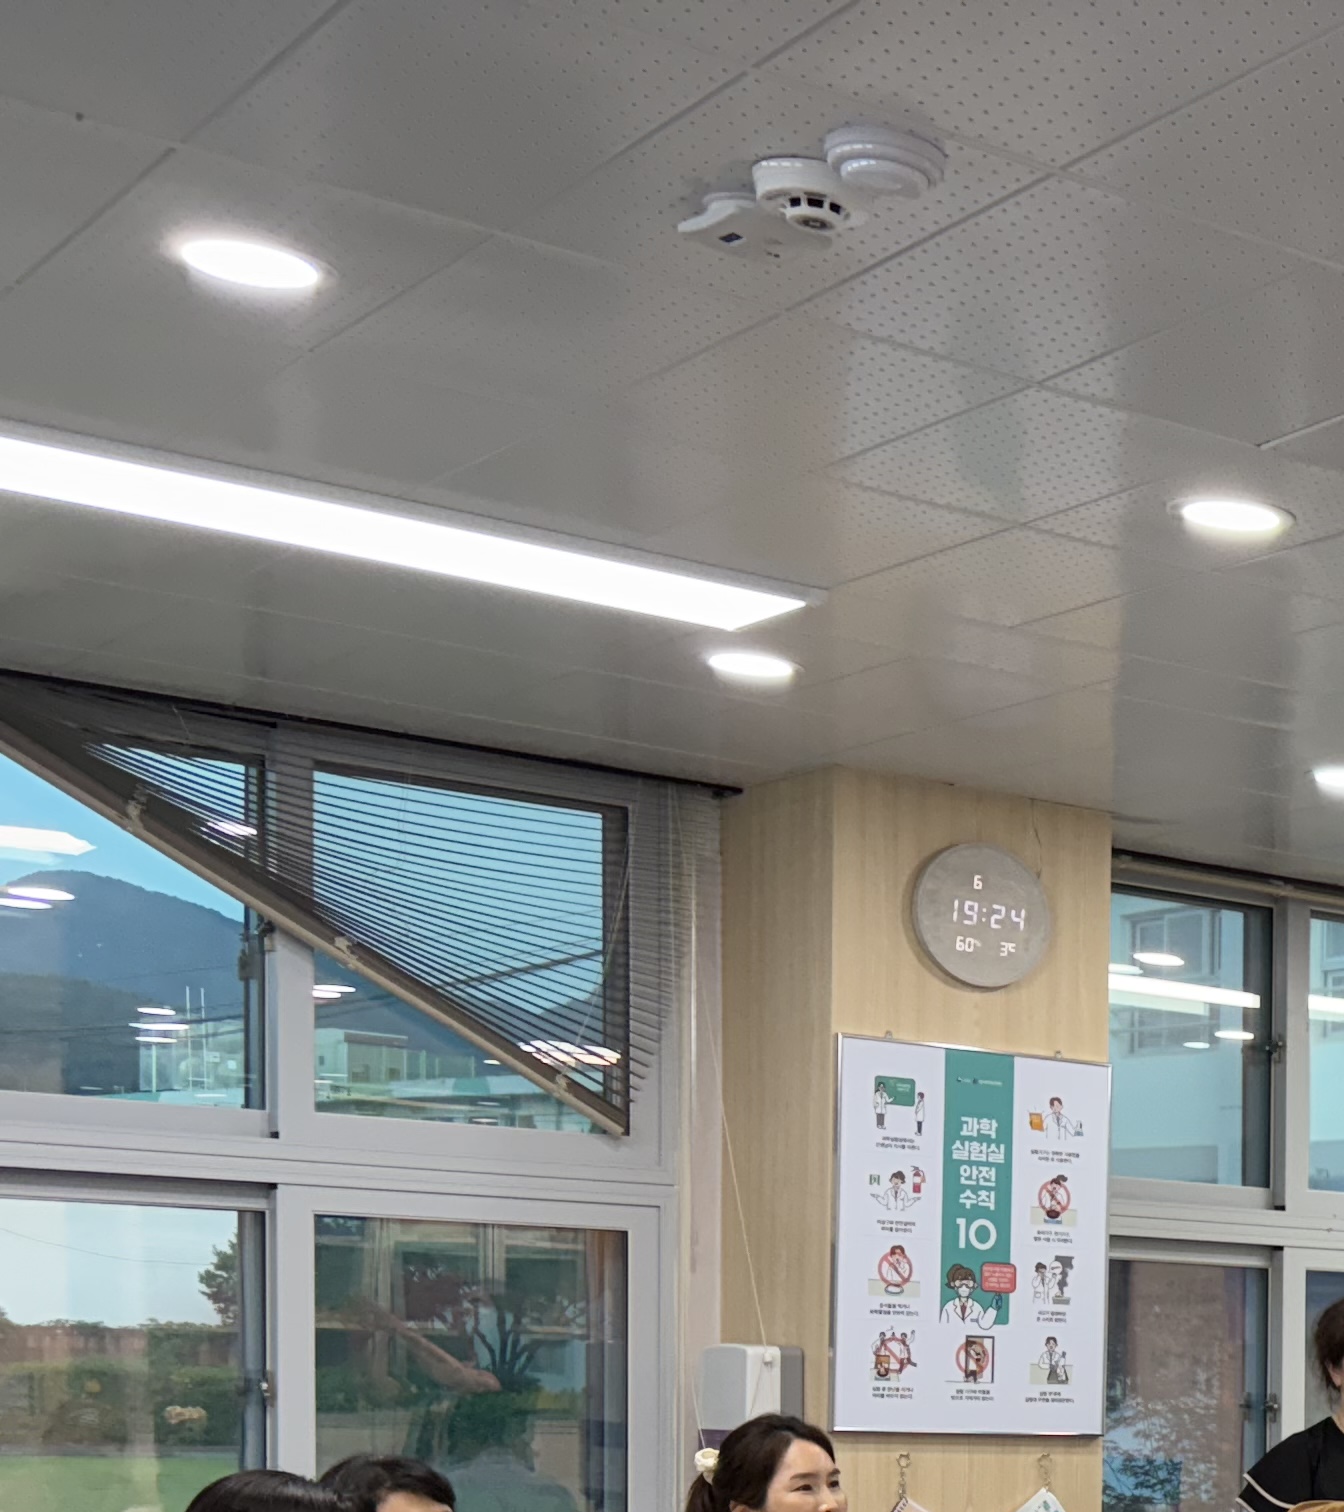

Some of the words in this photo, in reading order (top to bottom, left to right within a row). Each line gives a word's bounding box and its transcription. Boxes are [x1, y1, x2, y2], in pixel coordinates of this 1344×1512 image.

[973, 874, 983, 890] 6
[952, 899, 1026, 931] 19:24
[959, 1116, 999, 1139] 과학
[951, 1140, 1006, 1164] 실험실
[959, 1165, 997, 1187] 안전
[958, 1190, 996, 1211] 수칙
[955, 1217, 998, 1251] 10
